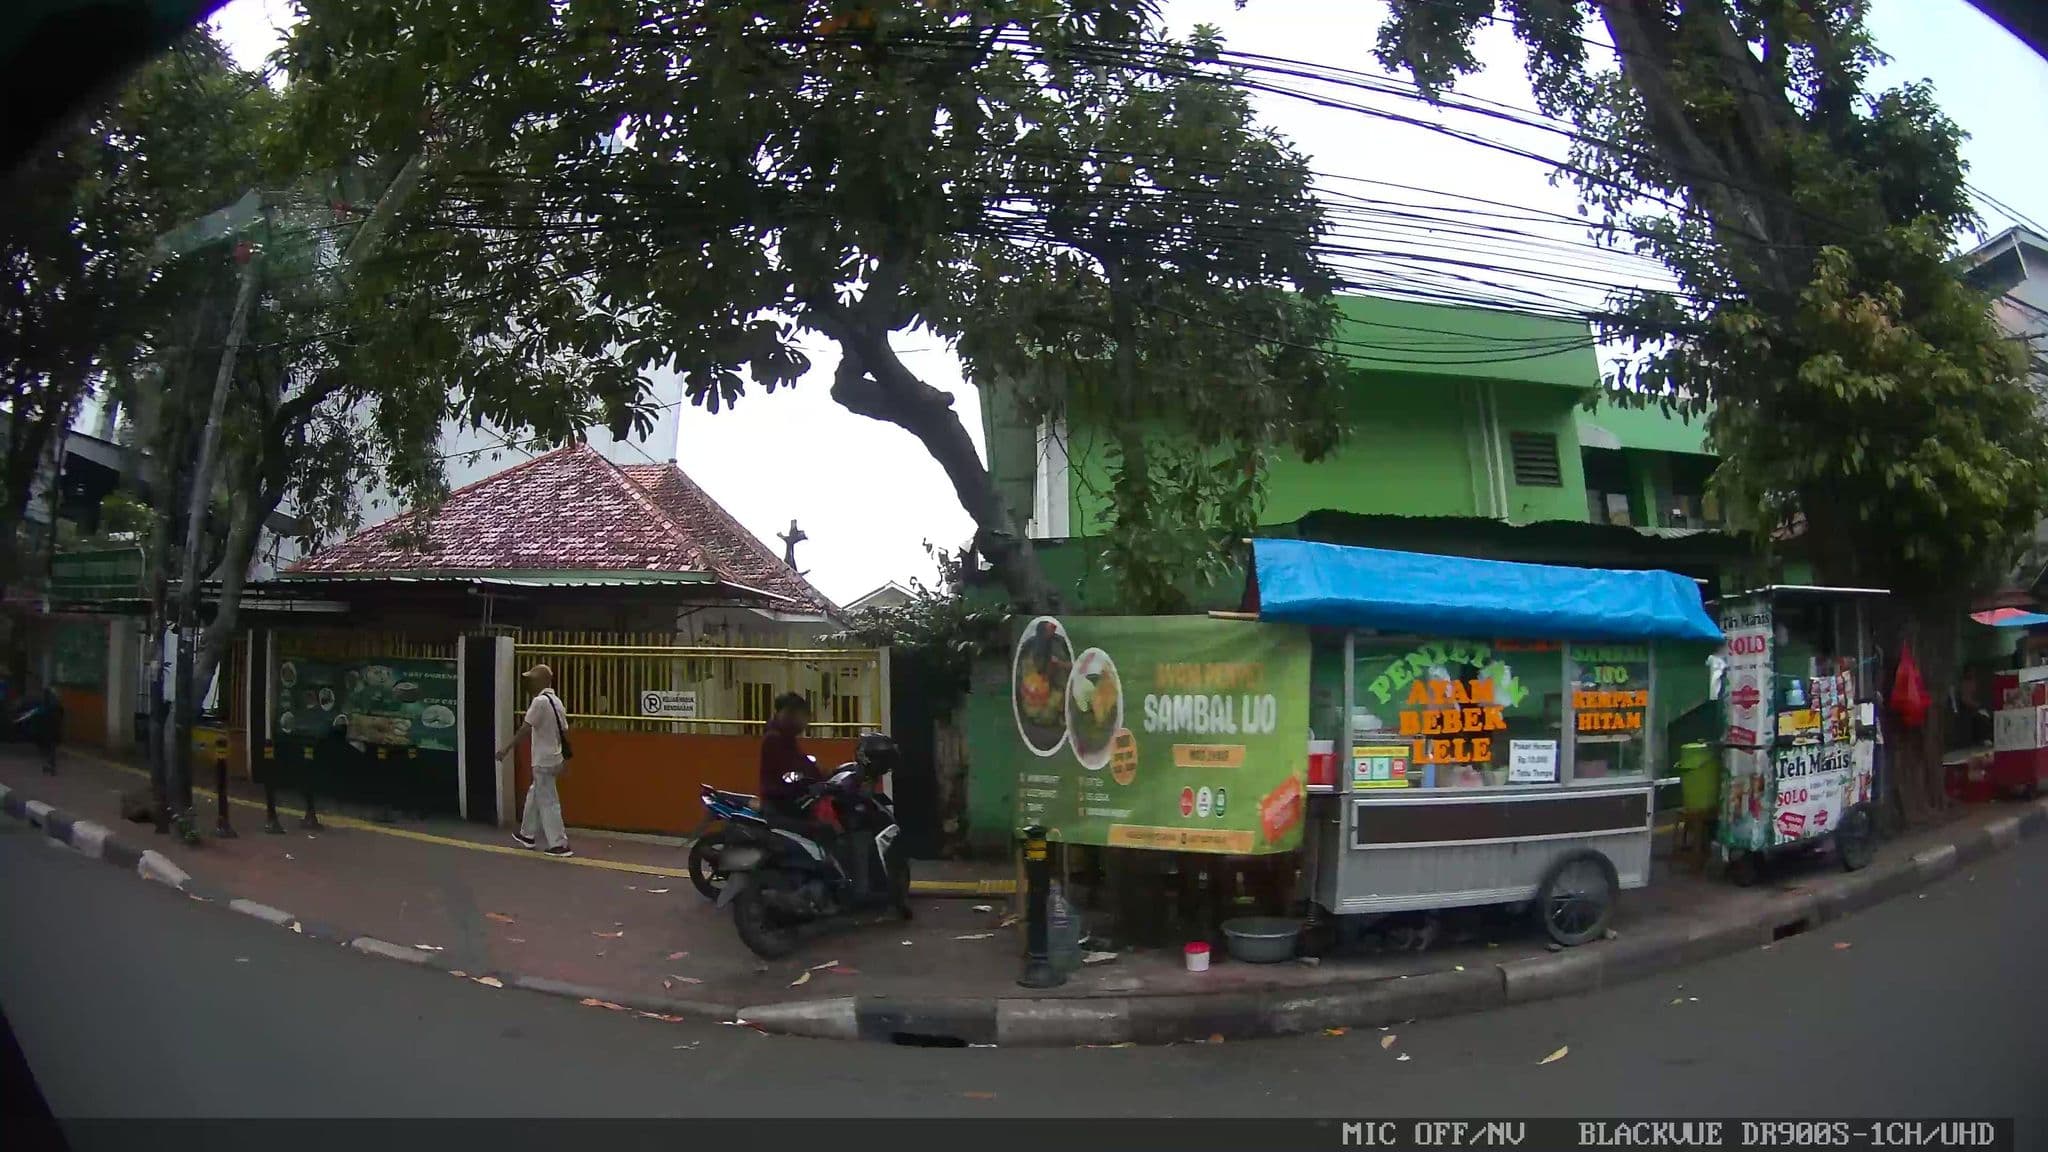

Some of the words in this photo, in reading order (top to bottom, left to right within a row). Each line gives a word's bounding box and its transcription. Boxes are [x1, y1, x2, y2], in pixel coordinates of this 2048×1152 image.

[1405, 679, 1495, 705] AYAM
[1144, 693, 1238, 734] SAMBAL
[1242, 693, 1277, 734] IJO
[1400, 704, 1507, 736] BEBEK
[1579, 712, 1641, 730] HITAM
[1412, 737, 1493, 765] LELE
[1778, 756, 1806, 778] Teh
[1809, 749, 1849, 774] Manis
[1777, 788, 1808, 807] SOLO
